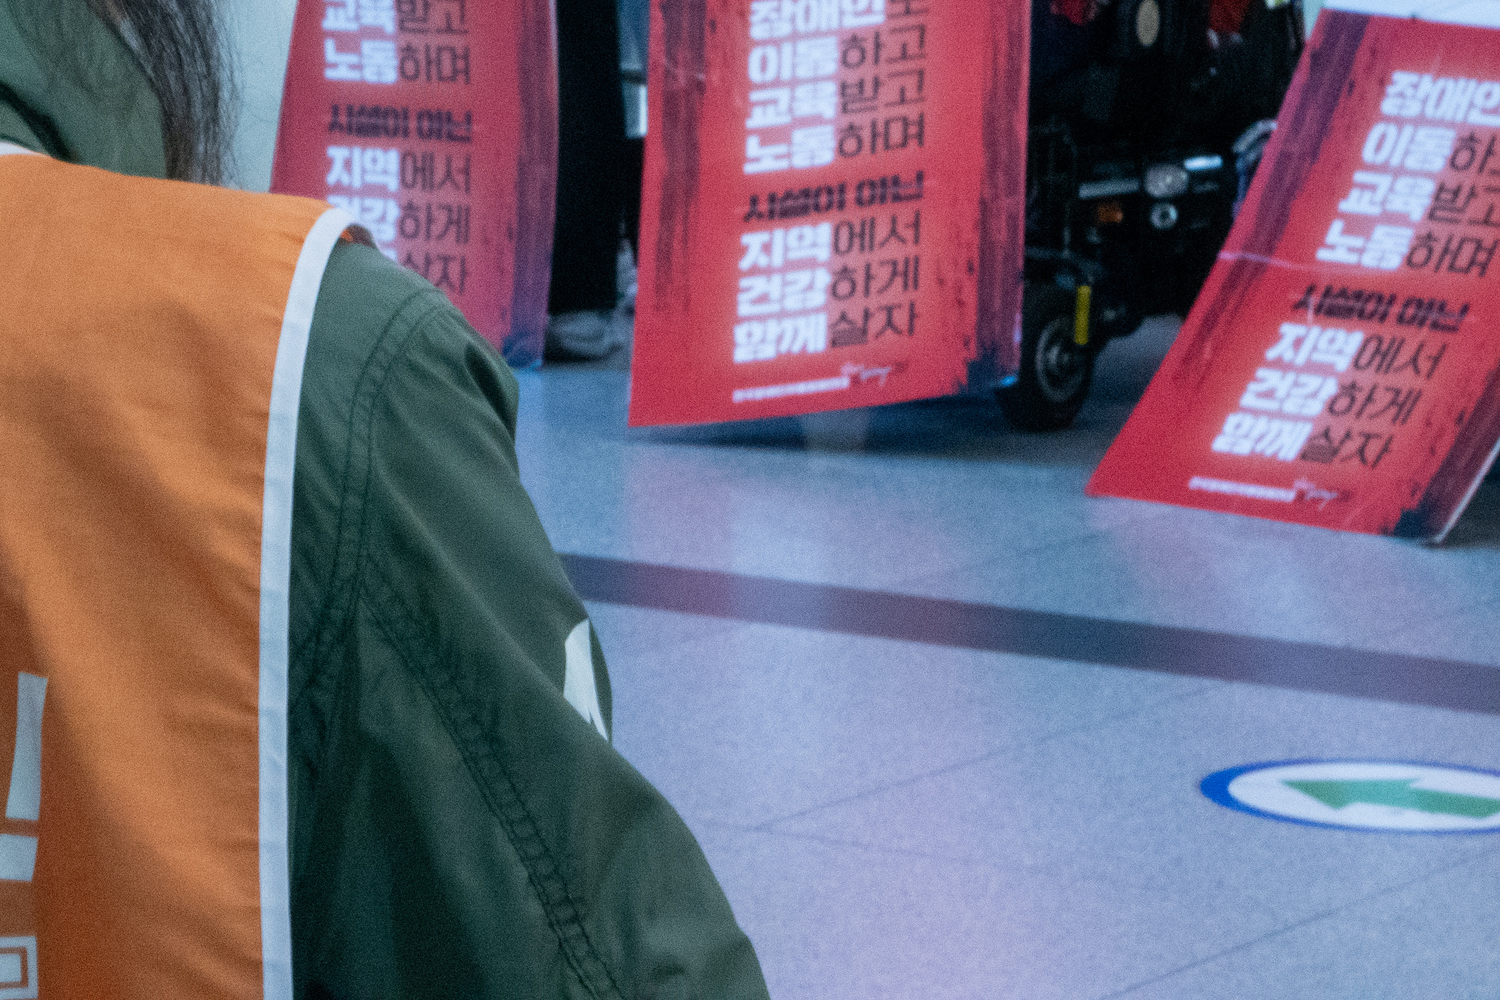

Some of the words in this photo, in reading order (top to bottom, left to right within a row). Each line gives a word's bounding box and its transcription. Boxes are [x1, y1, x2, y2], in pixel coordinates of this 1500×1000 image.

[324, 38, 472, 85] 노동하며
[748, 24, 927, 84] 이동하고
[328, 103, 409, 138] 시설이
[416, 108, 472, 143] 아닌
[745, 68, 925, 130] 교육받고
[326, 145, 471, 194] 지역에서
[743, 112, 925, 175] 노동하며
[1362, 121, 1500, 175] 이동하
[744, 181, 847, 222] 시설이
[855, 170, 925, 207] 아닌
[739, 209, 921, 271] 지역에서
[1315, 218, 1500, 277] 노동하며
[737, 254, 920, 317] 건강하게
[1265, 322, 1447, 380] 지역에서
[1239, 366, 1422, 425] 건강하게
